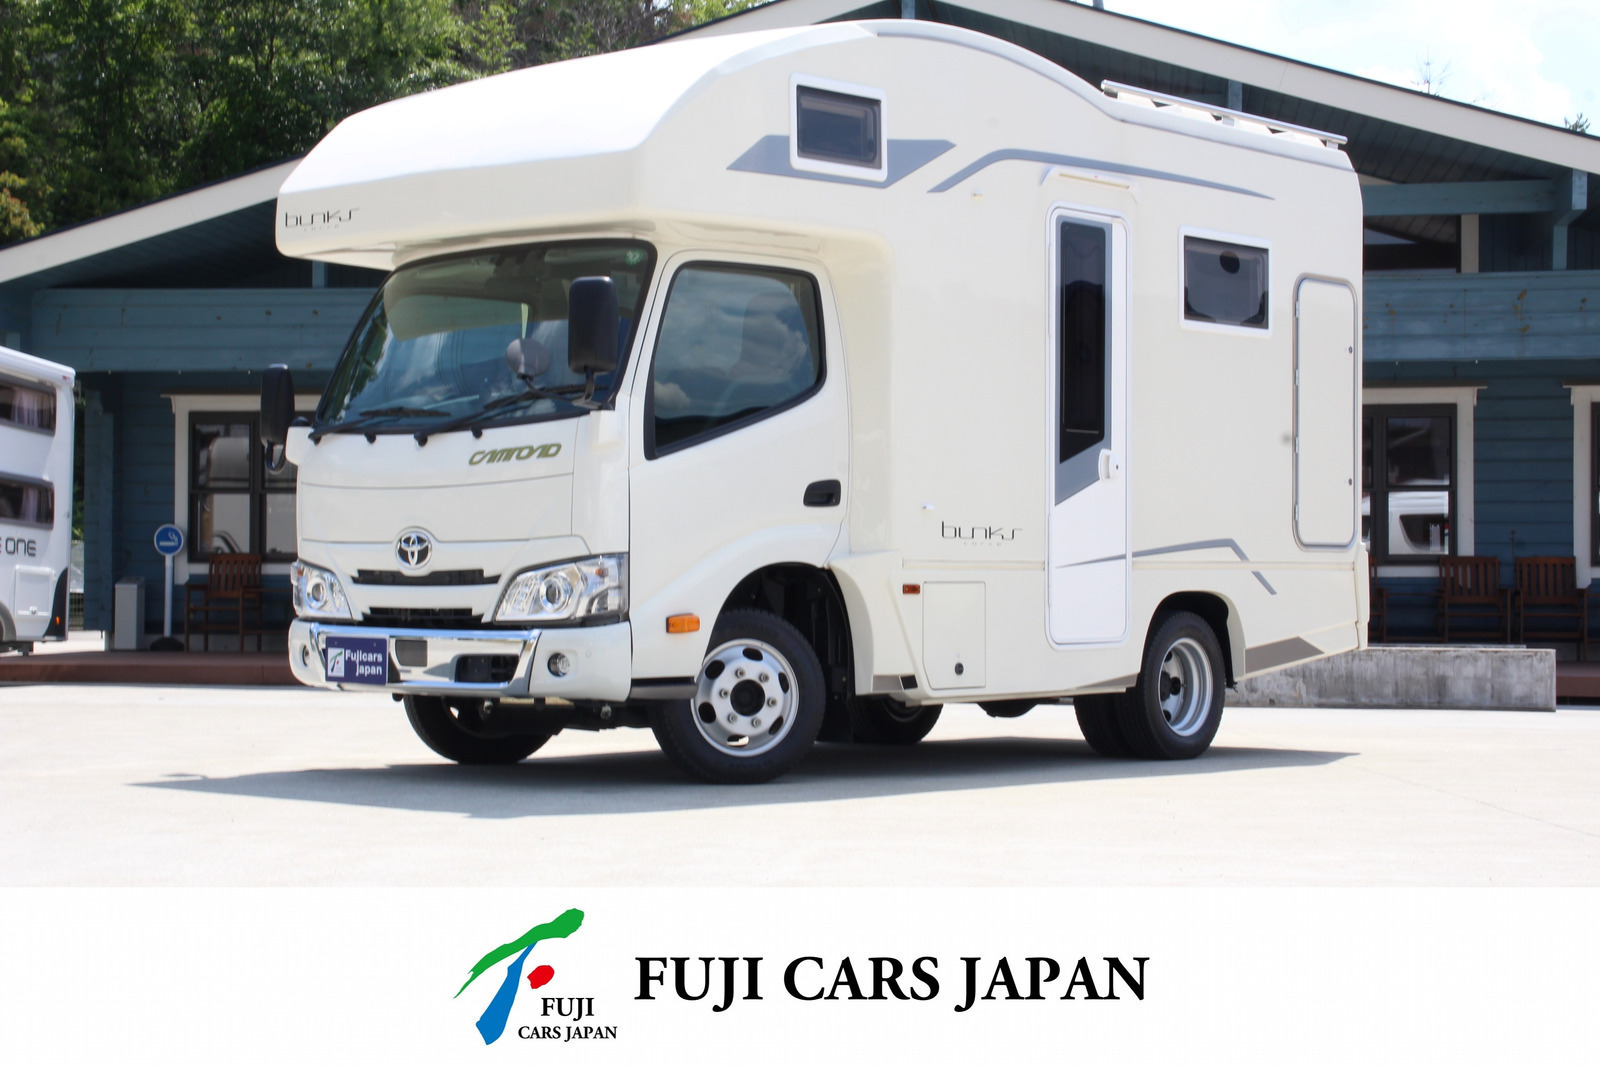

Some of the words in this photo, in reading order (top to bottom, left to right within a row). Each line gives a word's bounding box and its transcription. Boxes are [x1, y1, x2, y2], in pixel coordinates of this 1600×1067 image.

[284, 207, 361, 228] bunks
[468, 443, 562, 466] CAMROAD
[941, 520, 1023, 541] bunks
[5, 537, 37, 557] ONE
[345, 649, 383, 664] Fujicars
[356, 663, 383, 677] Japan
